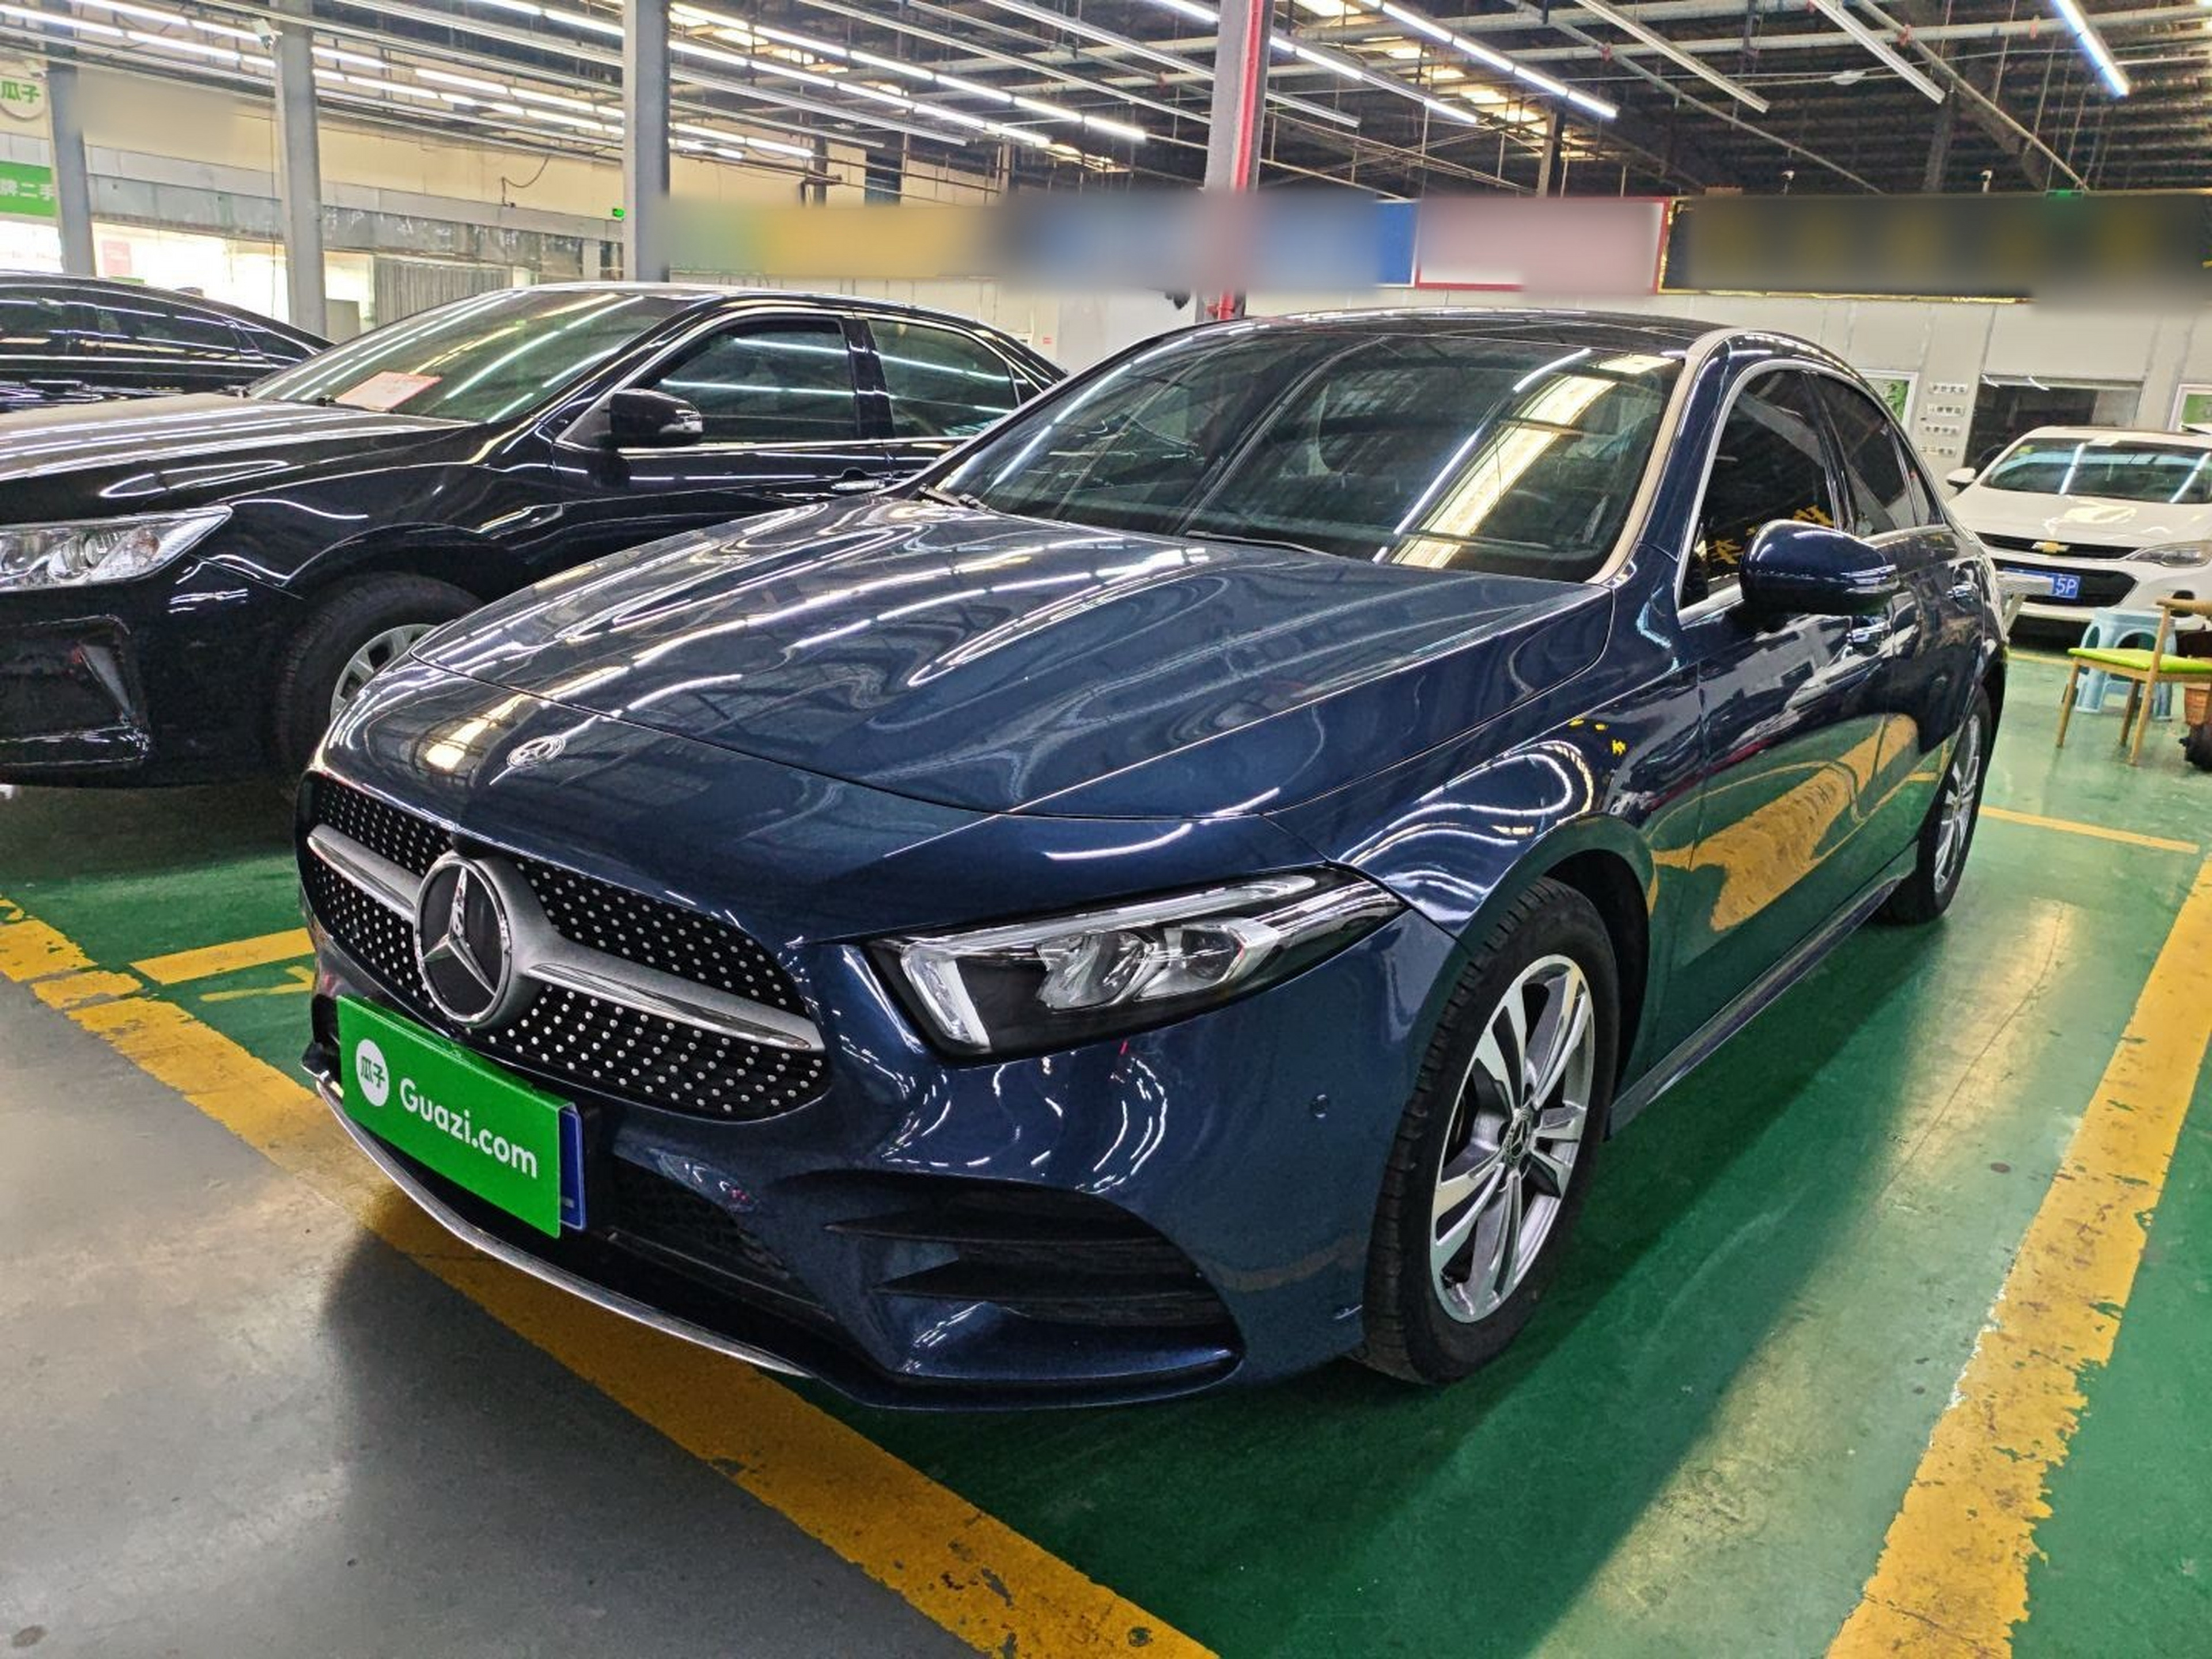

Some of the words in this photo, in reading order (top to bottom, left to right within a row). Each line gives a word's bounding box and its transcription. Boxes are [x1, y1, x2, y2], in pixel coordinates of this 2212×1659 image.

[2, 81, 40, 104] 瓜子
[361, 1056, 385, 1089] 瓜子
[400, 1077, 537, 1179] Guazi.com
